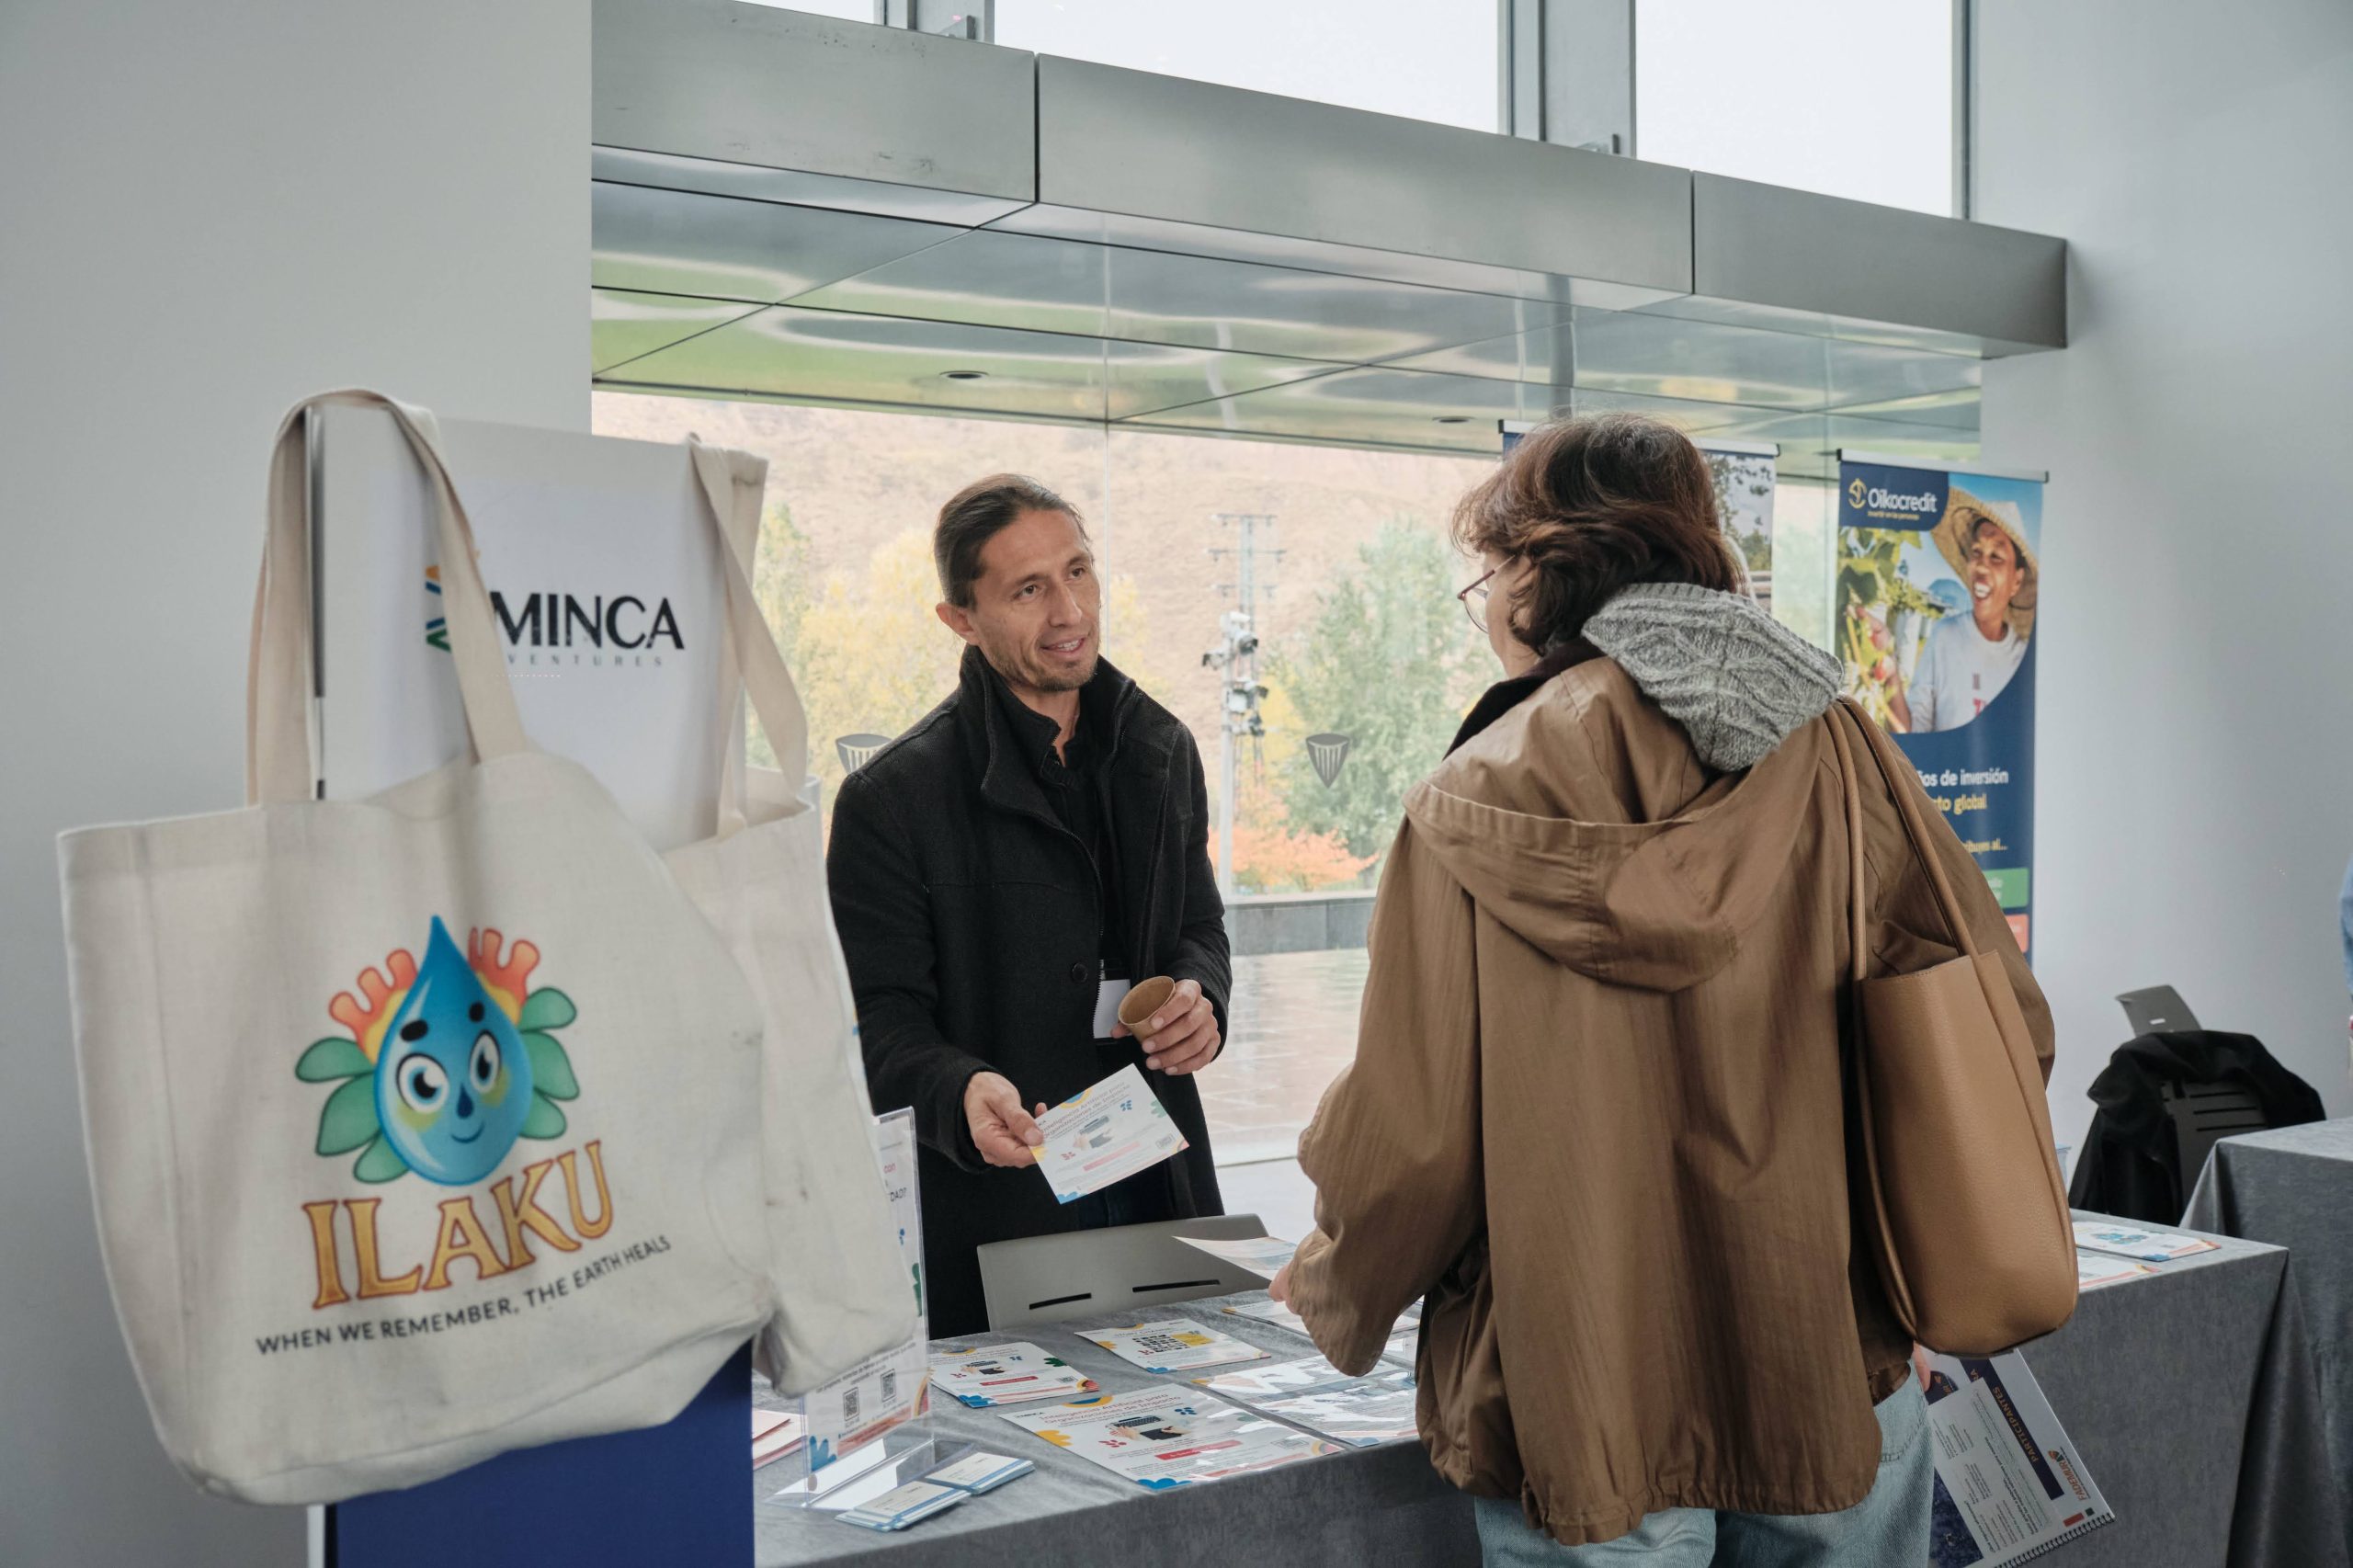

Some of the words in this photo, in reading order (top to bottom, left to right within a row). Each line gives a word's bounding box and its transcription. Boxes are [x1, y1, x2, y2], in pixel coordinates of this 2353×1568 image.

[1867, 487, 1938, 513] Oikocredit
[489, 591, 685, 650] MINCA
[507, 654, 662, 666] VENTURES
[1939, 768, 1958, 786] de
[1960, 767, 2009, 786] inversión
[1953, 792, 1987, 815] global
[302, 1140, 613, 1310] ILAKU
[256, 1326, 332, 1355] WHEN
[337, 1321, 374, 1342] WE
[380, 1298, 520, 1339] REMEMBER,
[523, 1277, 569, 1308] THE
[572, 1256, 621, 1289] EARTH
[622, 1235, 672, 1267] HEALS
[1993, 1386, 2040, 1463] PARTICIPANTES
[2059, 1459, 2087, 1501] FADEMUR
